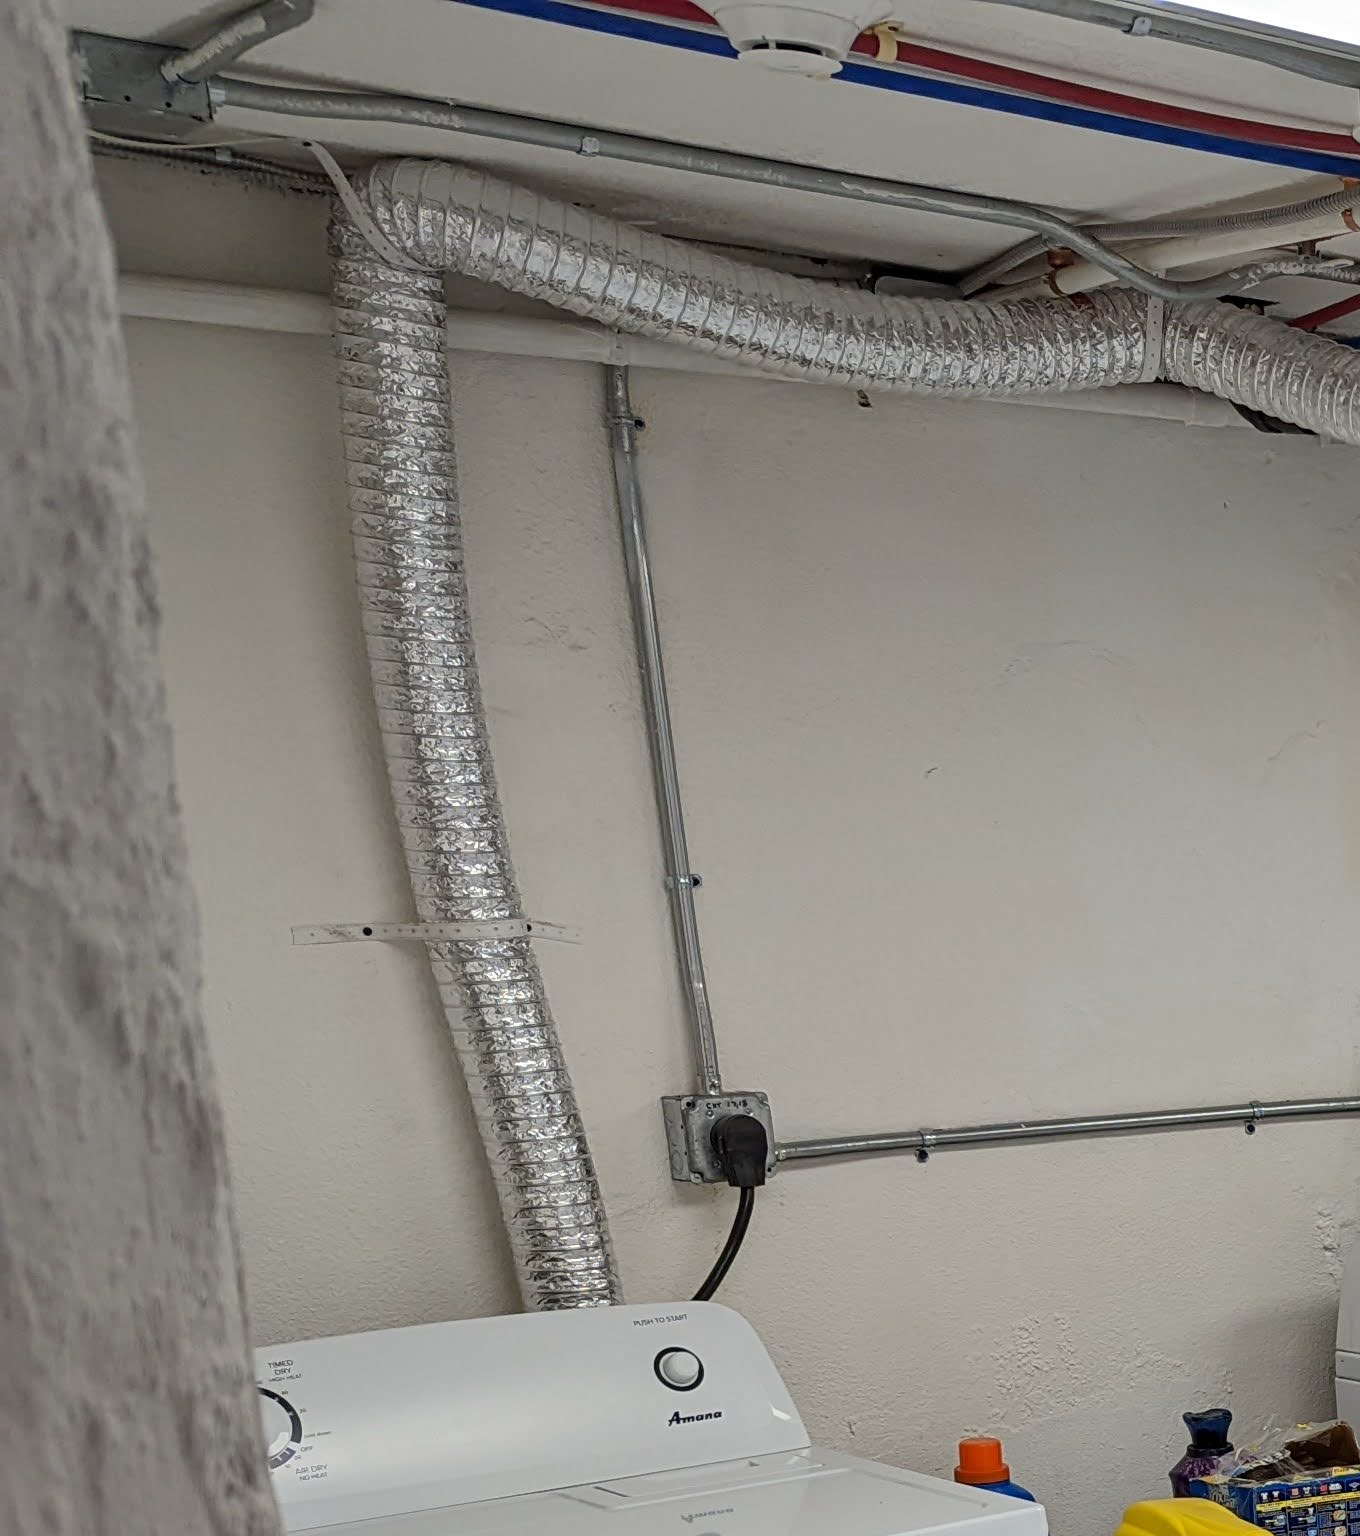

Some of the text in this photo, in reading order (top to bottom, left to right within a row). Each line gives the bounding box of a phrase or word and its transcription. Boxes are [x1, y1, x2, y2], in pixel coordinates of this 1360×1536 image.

[633, 1319, 654, 1327] PUSH
[666, 1313, 688, 1323] START
[668, 1410, 723, 1427] Amana
